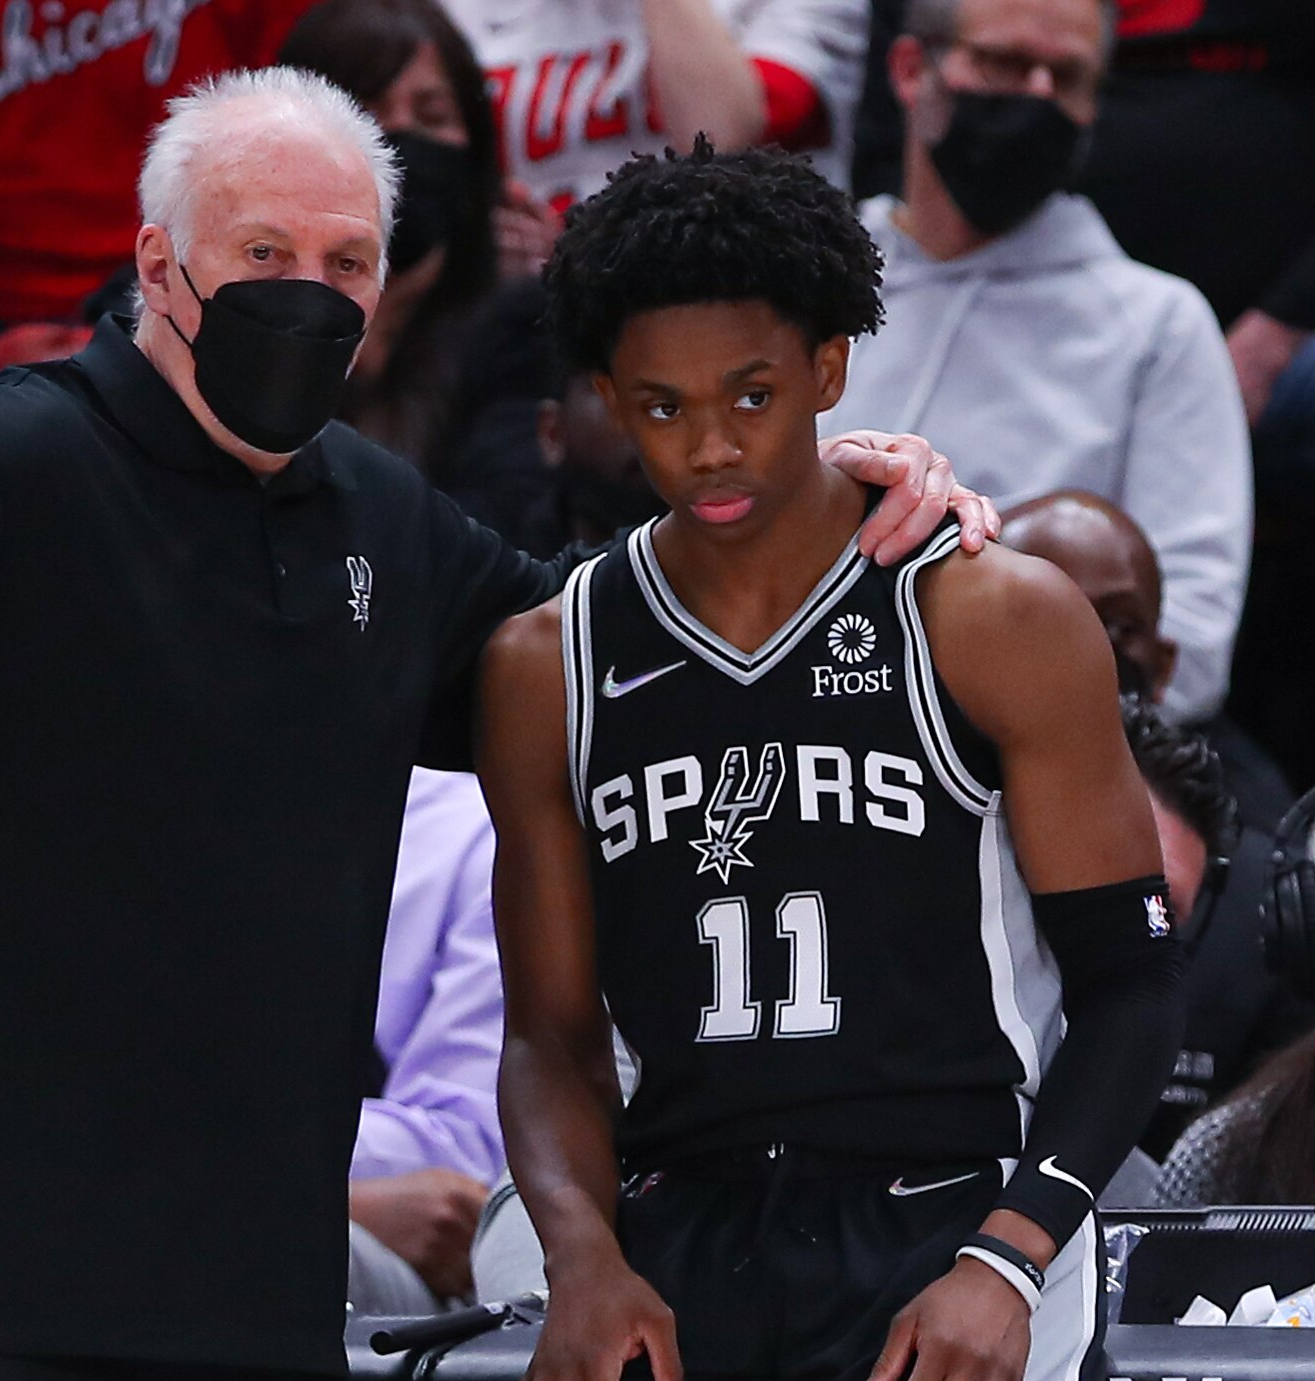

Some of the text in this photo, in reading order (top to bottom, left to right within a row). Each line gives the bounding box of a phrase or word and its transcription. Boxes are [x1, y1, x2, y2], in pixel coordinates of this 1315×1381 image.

[811, 664, 893, 697] Frost
[591, 742, 926, 885] SPURS
[695, 891, 842, 1042] 11
